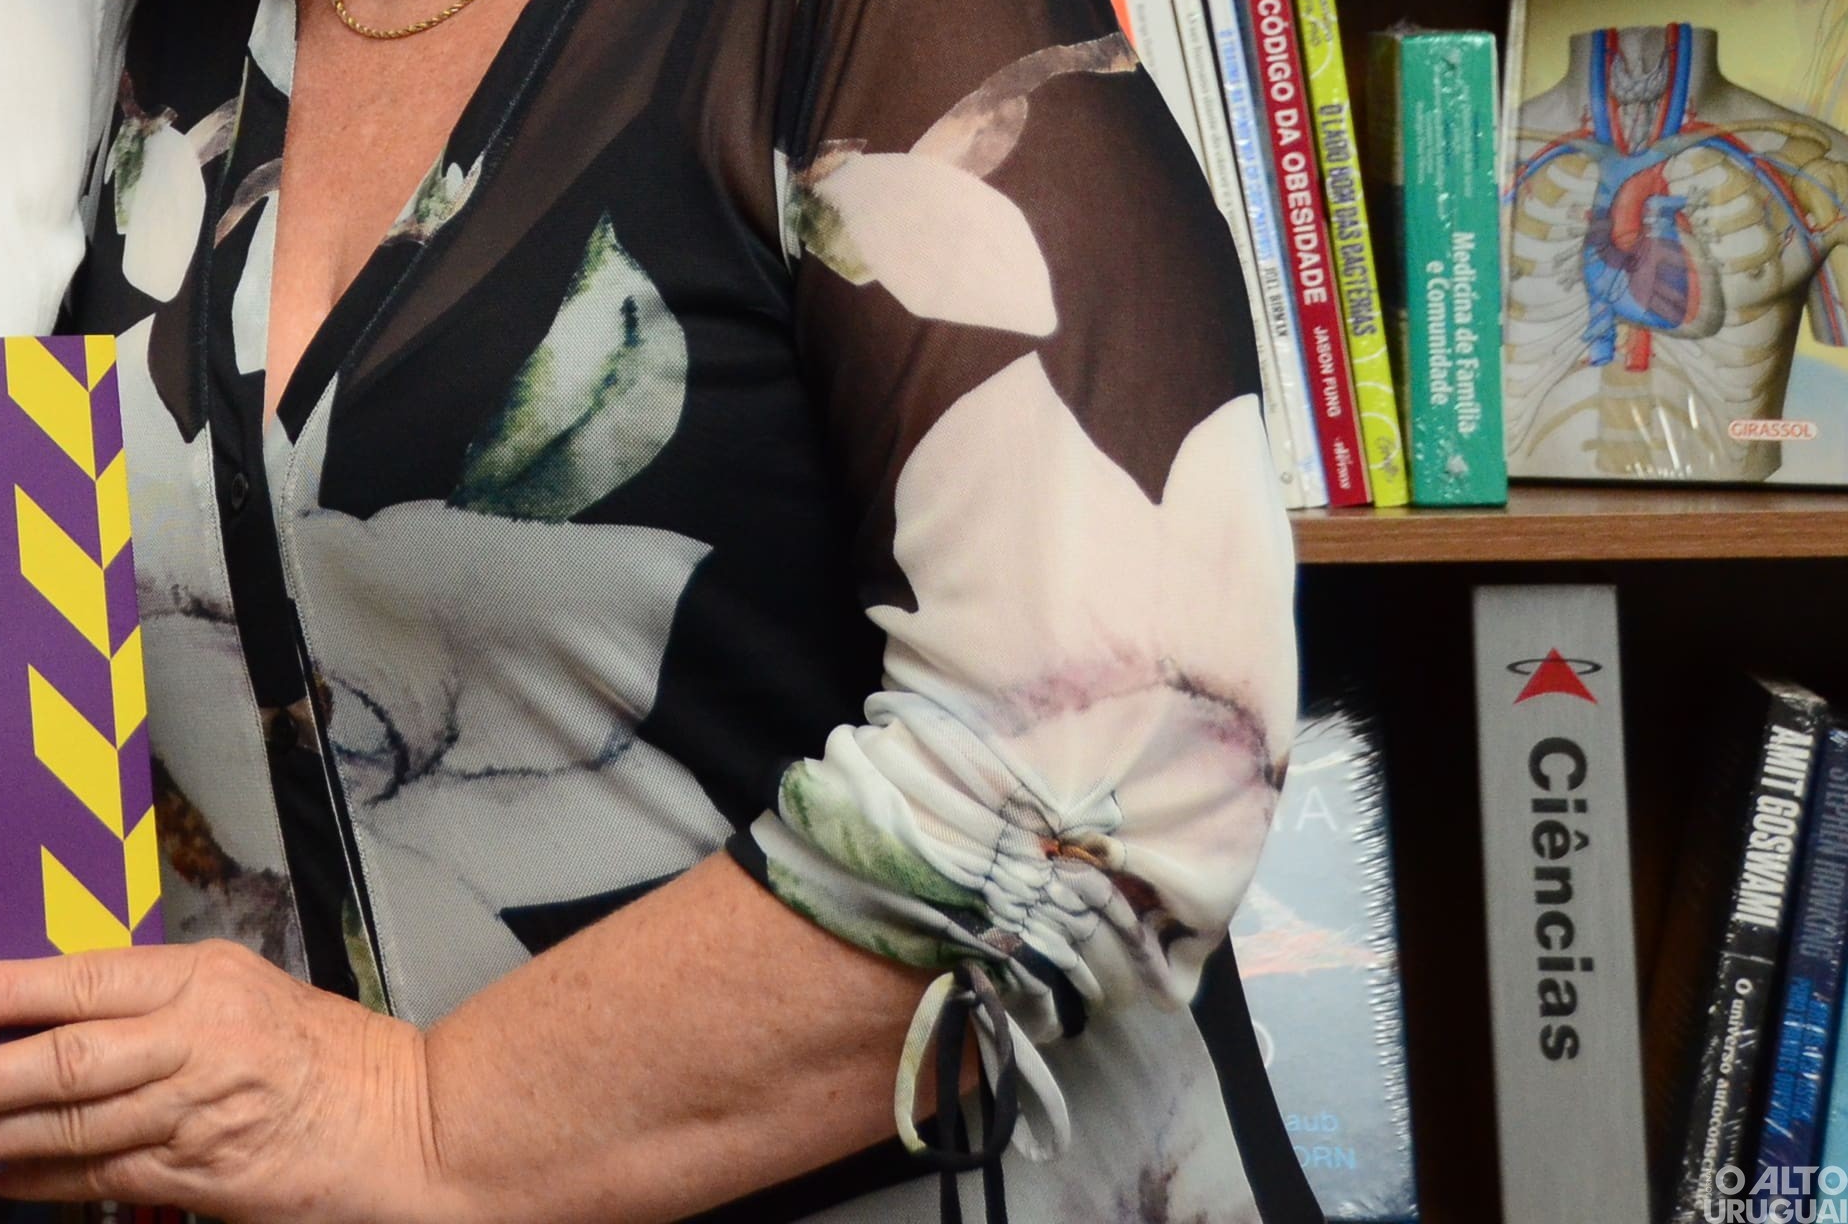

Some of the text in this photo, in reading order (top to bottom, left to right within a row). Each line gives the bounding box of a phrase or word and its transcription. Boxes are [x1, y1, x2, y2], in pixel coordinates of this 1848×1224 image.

[1272, 108, 1301, 148] DA
[1277, 151, 1328, 308] OBESIDADE
[1317, 100, 1380, 339] O LADO BOM DAS BACTÉRIAS
[1262, 265, 1290, 340] JOEL BIRMAN
[1308, 324, 1338, 377] JASON
[1421, 259, 1459, 406] e Comunidade
[1451, 231, 1481, 435] Medicina de Família
[1318, 375, 1345, 420] FUNG
[1729, 422, 1813, 440] GIRASSOL
[1735, 723, 1814, 930] AMIT GOSWAMI
[1528, 736, 1595, 1063] Ciências
[1797, 857, 1848, 963] HAWKING
[1715, 975, 1756, 1077] O universo
